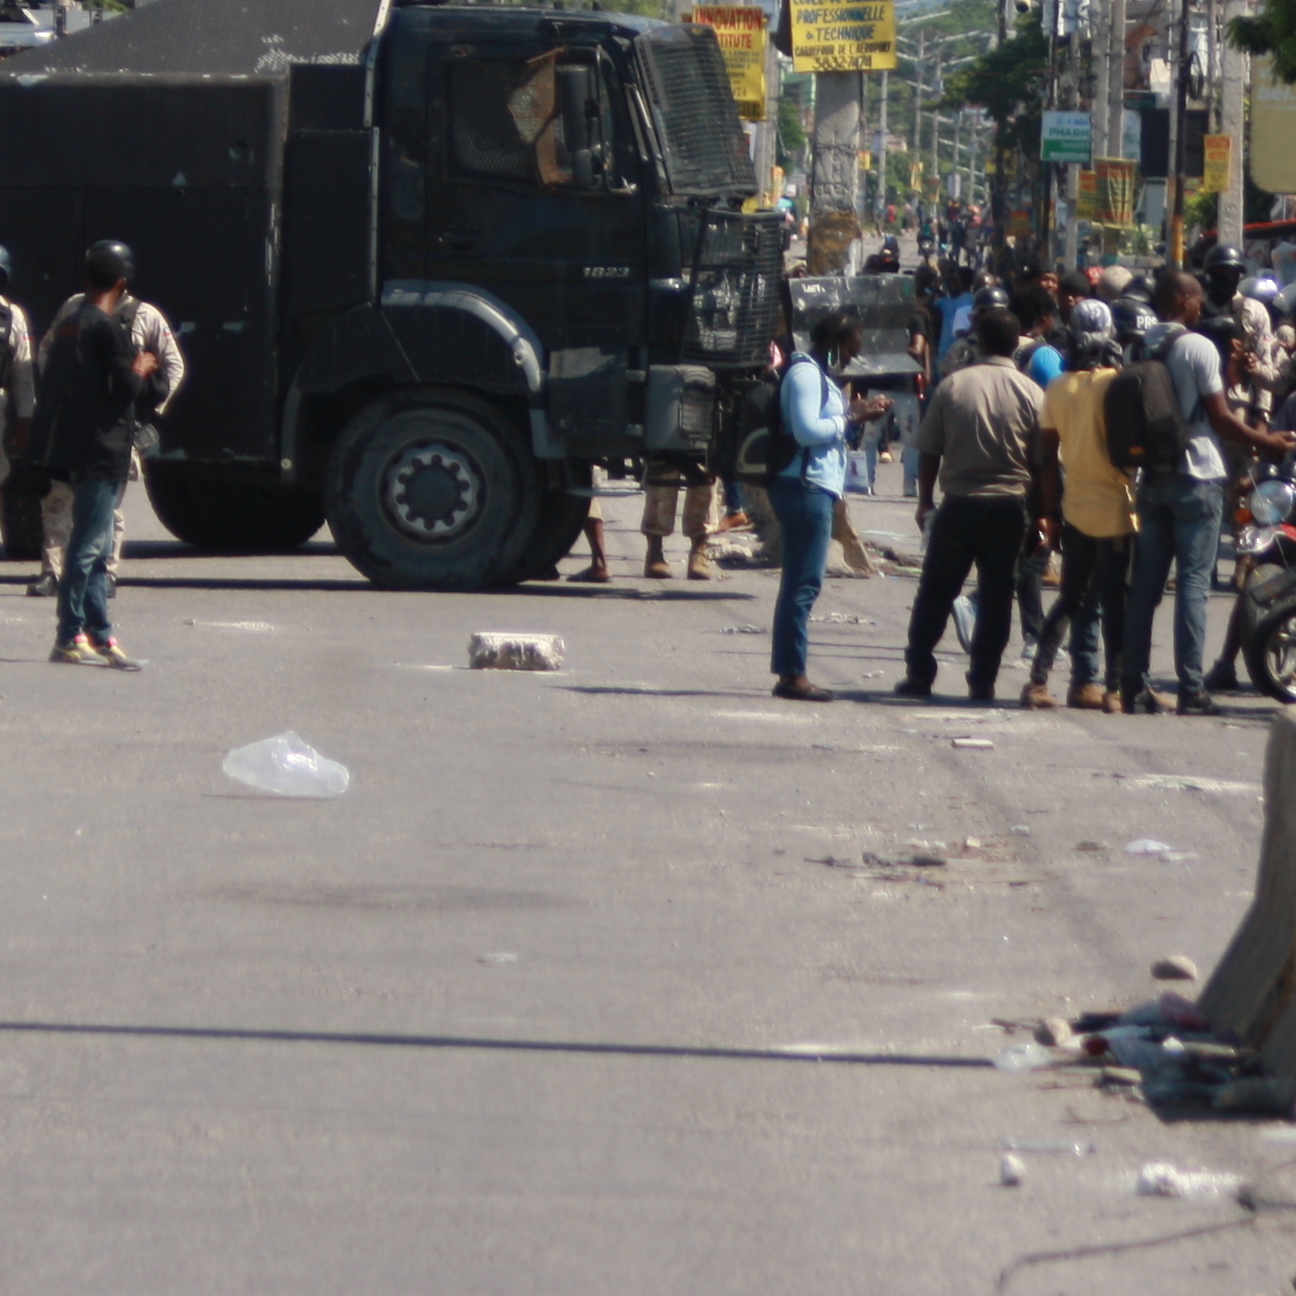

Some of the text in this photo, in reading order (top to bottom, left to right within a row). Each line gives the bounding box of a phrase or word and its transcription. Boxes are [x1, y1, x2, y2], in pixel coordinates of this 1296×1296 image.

[695, 8, 763, 30] INNOVATION
[797, 5, 885, 24] PROFESSIONNELLE
[816, 25, 875, 41] TECHNIQUE
